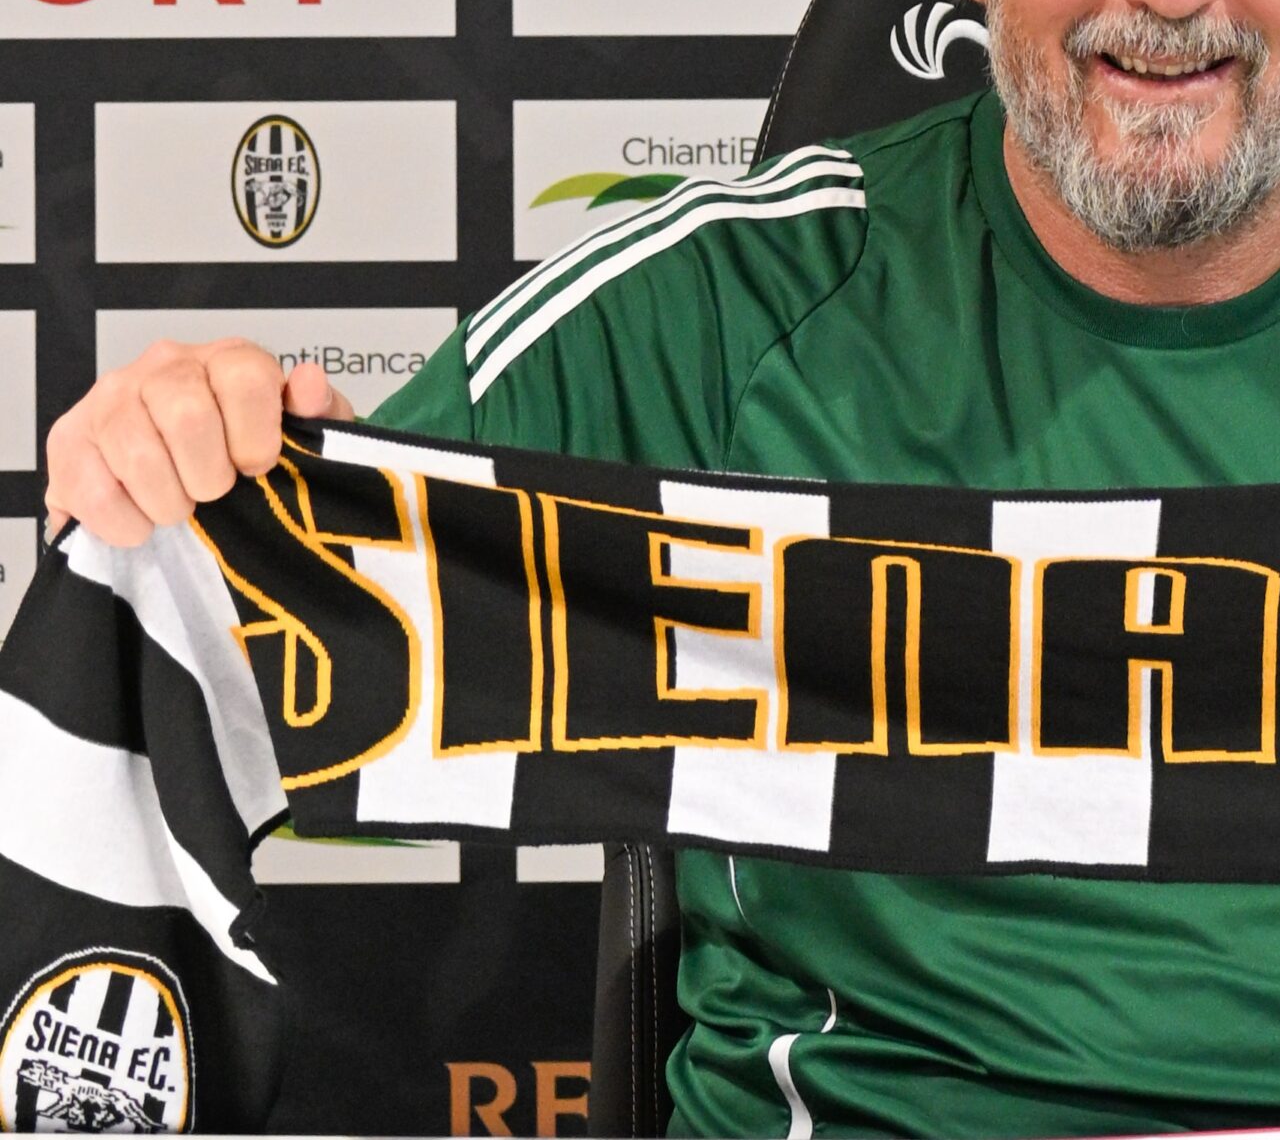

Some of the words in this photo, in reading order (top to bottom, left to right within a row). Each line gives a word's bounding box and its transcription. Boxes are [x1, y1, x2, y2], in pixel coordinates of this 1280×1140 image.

[191, 434, 1280, 790] SIENA
[25, 1009, 121, 1071] SIENA
[127, 1047, 176, 1093] F.C.
